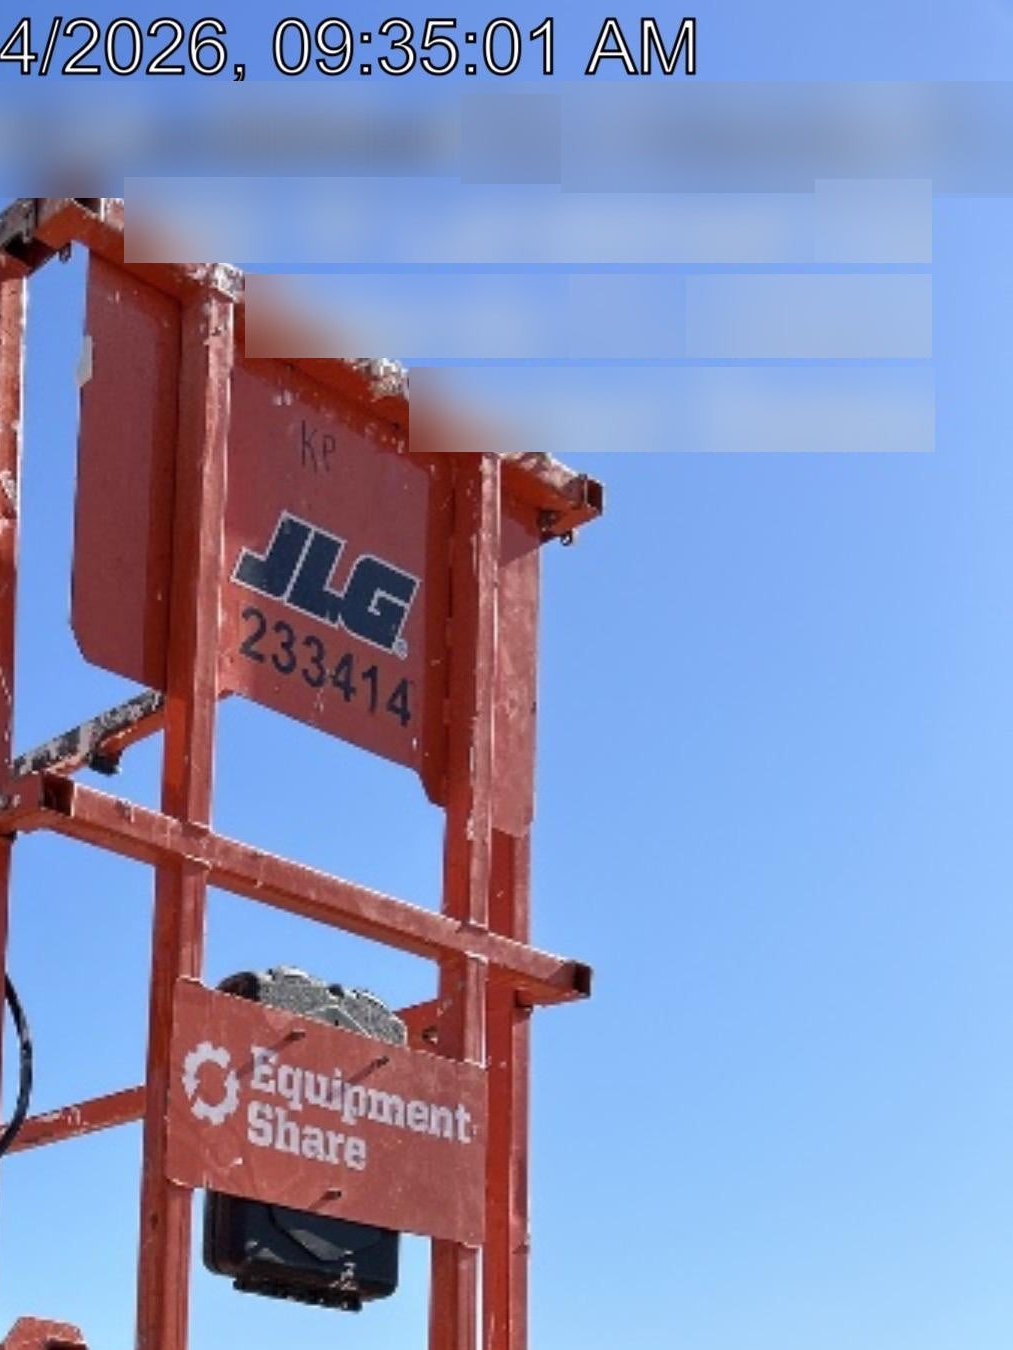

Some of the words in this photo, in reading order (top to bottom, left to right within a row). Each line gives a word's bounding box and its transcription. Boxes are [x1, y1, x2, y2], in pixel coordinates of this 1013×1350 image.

[230, 509, 422, 658] JLG
[239, 606, 416, 728] 233414
[246, 1099, 368, 1171] Share
[249, 1046, 472, 1145] Equipment
